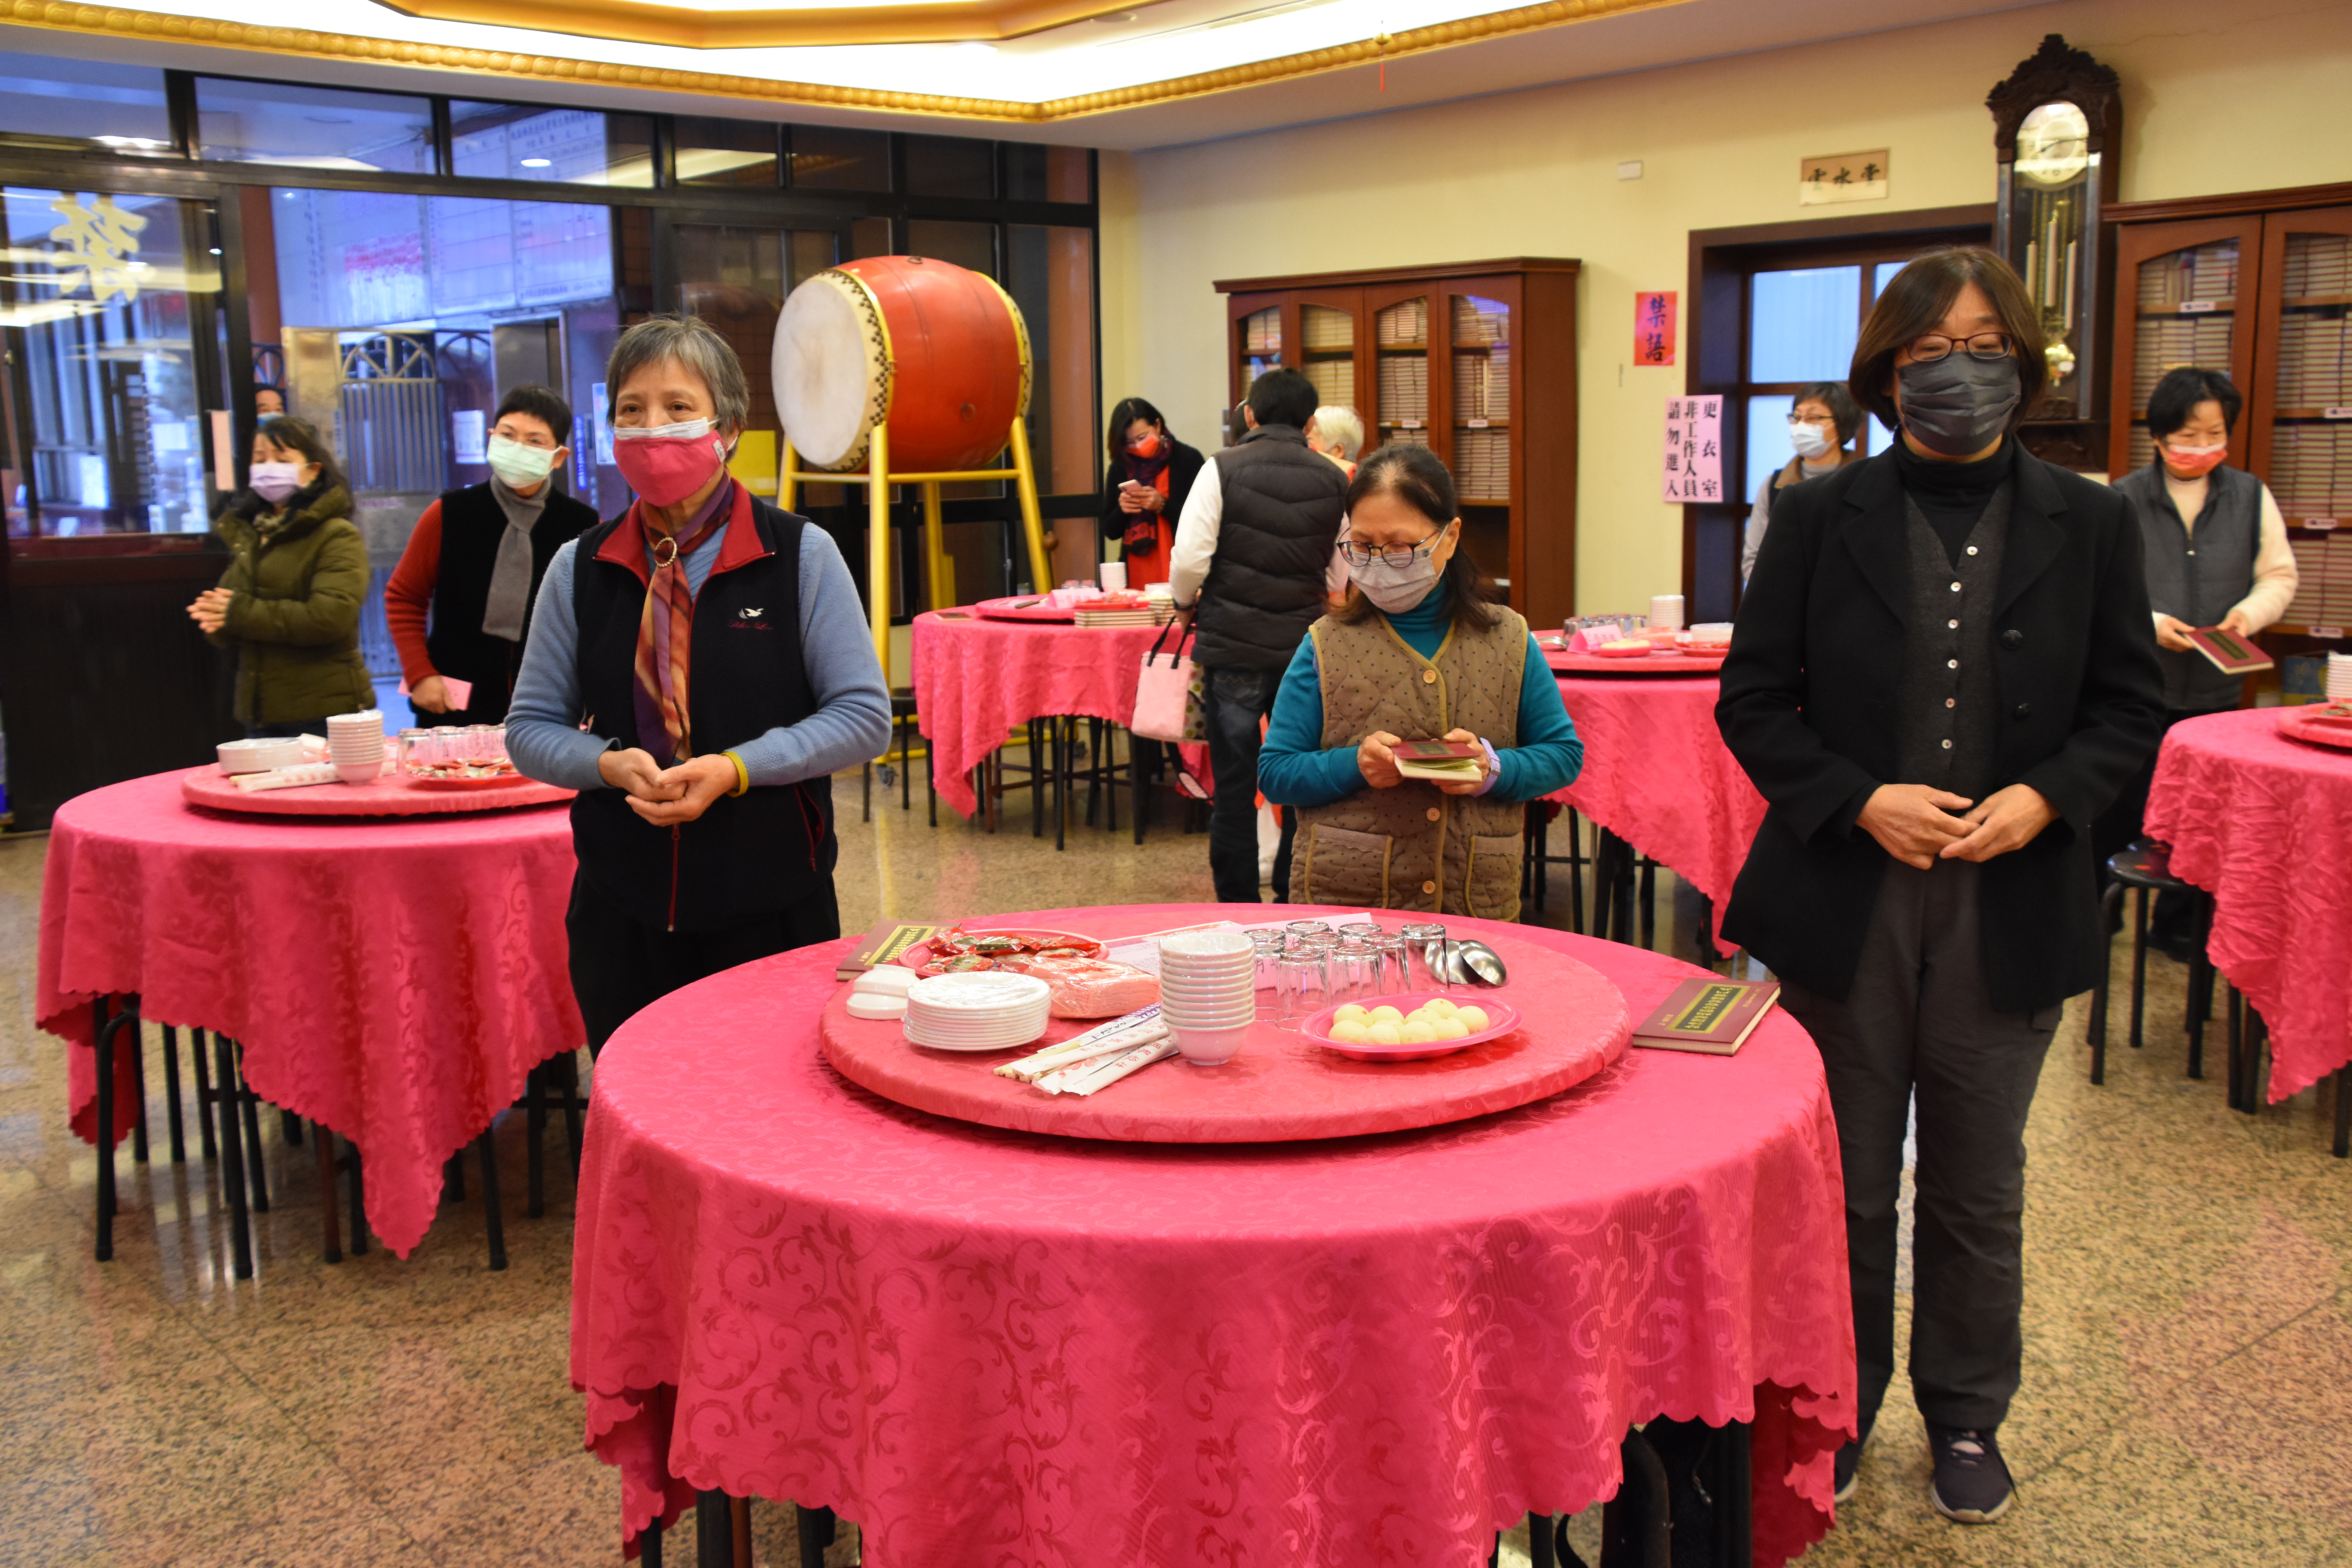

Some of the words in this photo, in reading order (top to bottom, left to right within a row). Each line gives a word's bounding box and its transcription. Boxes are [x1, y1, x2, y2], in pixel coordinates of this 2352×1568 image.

[1645, 294, 1666, 362] 禁語
[1665, 401, 1681, 497] 請勿進入
[1683, 400, 1699, 497] 非工作人員
[1701, 400, 1719, 497] 更衣室
